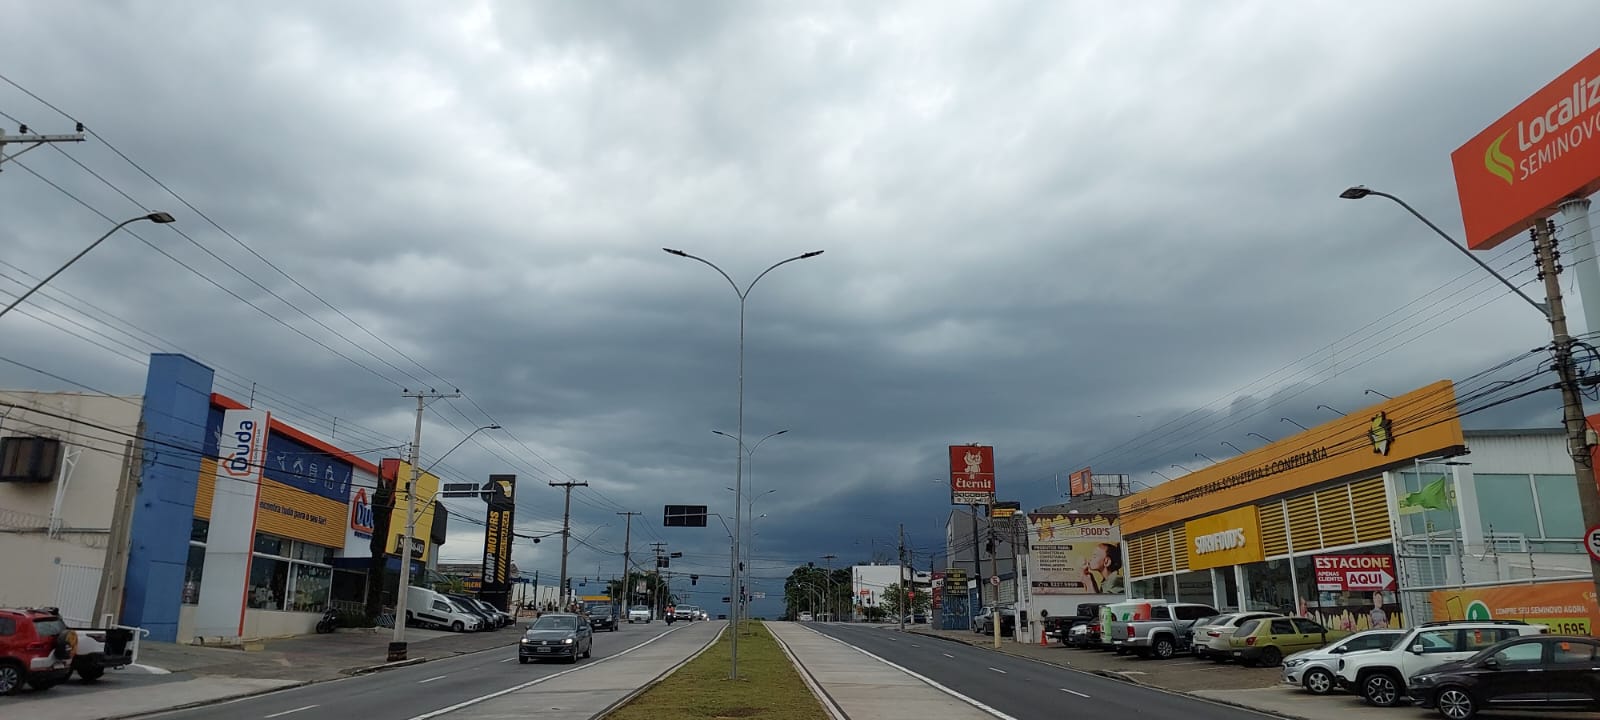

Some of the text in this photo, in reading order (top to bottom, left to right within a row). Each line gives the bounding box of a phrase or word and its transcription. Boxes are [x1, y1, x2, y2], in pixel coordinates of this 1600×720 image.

[231, 420, 253, 471] Duda
[1271, 446, 1328, 473] CONFEITARIA
[956, 477, 991, 489] Eternit
[1315, 557, 1390, 569] ESTACIONE
[1349, 573, 1383, 584] AQUI
